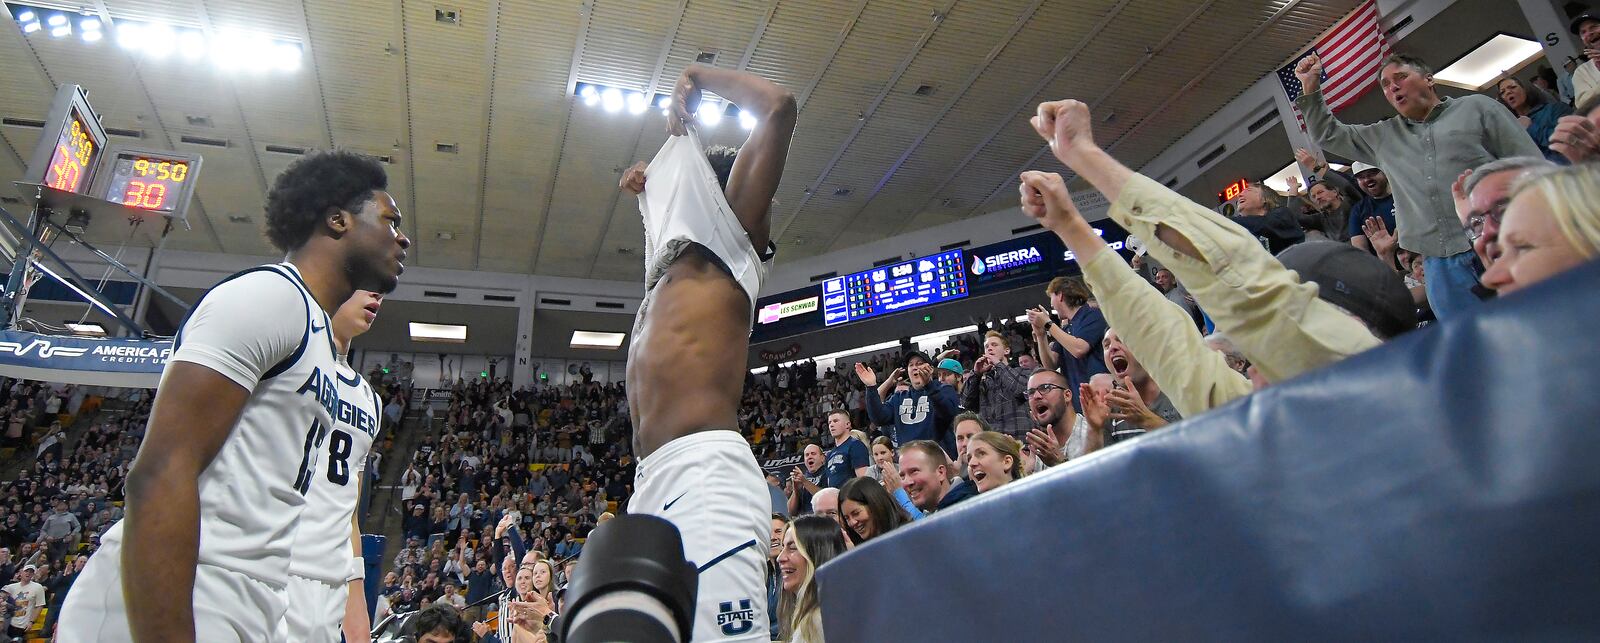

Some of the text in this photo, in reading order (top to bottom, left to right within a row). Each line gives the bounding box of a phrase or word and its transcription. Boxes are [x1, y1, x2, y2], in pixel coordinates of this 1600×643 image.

[1546, 32, 1559, 46] S
[134, 160, 188, 182] 9:50
[124, 181, 167, 209] 30
[985, 246, 1041, 268] SIERRA
[987, 255, 1043, 273] RESTORATION
[790, 300, 816, 313] SCHWAB
[92, 345, 158, 358] AMERICA
[102, 356, 145, 364] CREDIT
[519, 357, 527, 366] N
[327, 429, 353, 487] 8
[764, 455, 802, 467] UTAH
[717, 609, 754, 626] STATE
